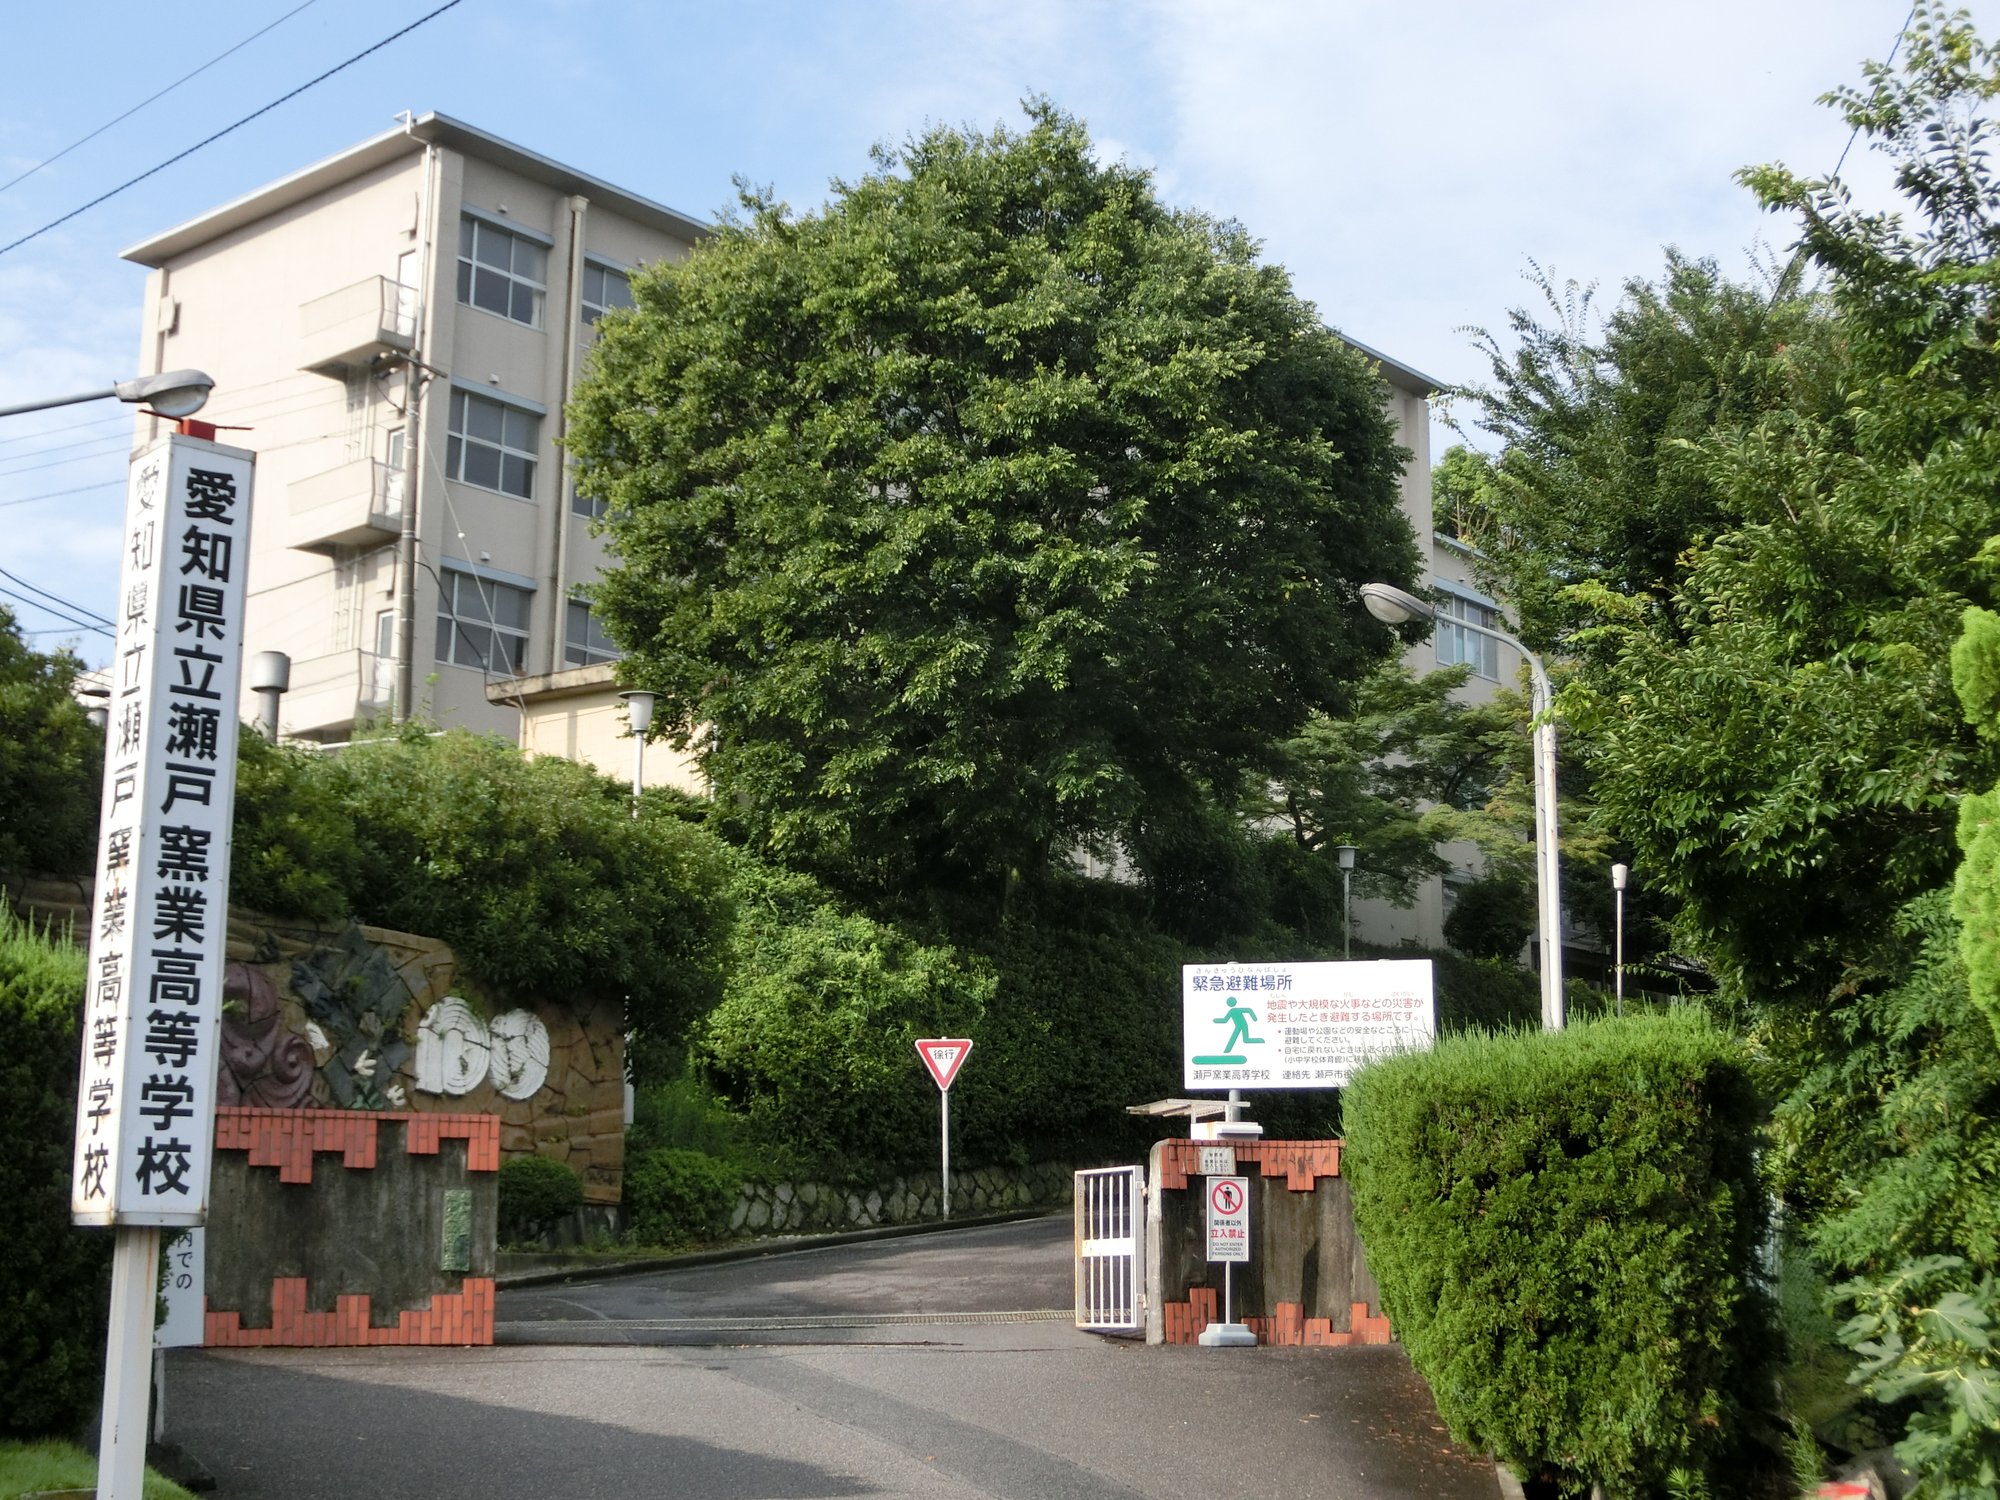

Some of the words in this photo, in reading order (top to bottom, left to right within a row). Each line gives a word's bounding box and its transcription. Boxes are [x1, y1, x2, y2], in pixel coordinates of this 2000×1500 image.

[135, 467, 236, 1196] 愛知県立瀬戸窯業高等学校
[1193, 975, 1292, 991] 緊急避難場所
[1266, 997, 1424, 1010] 地震や大規模な火事などの災害が
[1266, 1010, 1418, 1023] 発生したとき避難する場所です。
[933, 1049, 954, 1060] 徐行
[1193, 1069, 1271, 1080] 瀬戸窯業高等学校
[1282, 1070, 1311, 1079] 連絡先
[1210, 1228, 1245, 1239] 立入禁止
